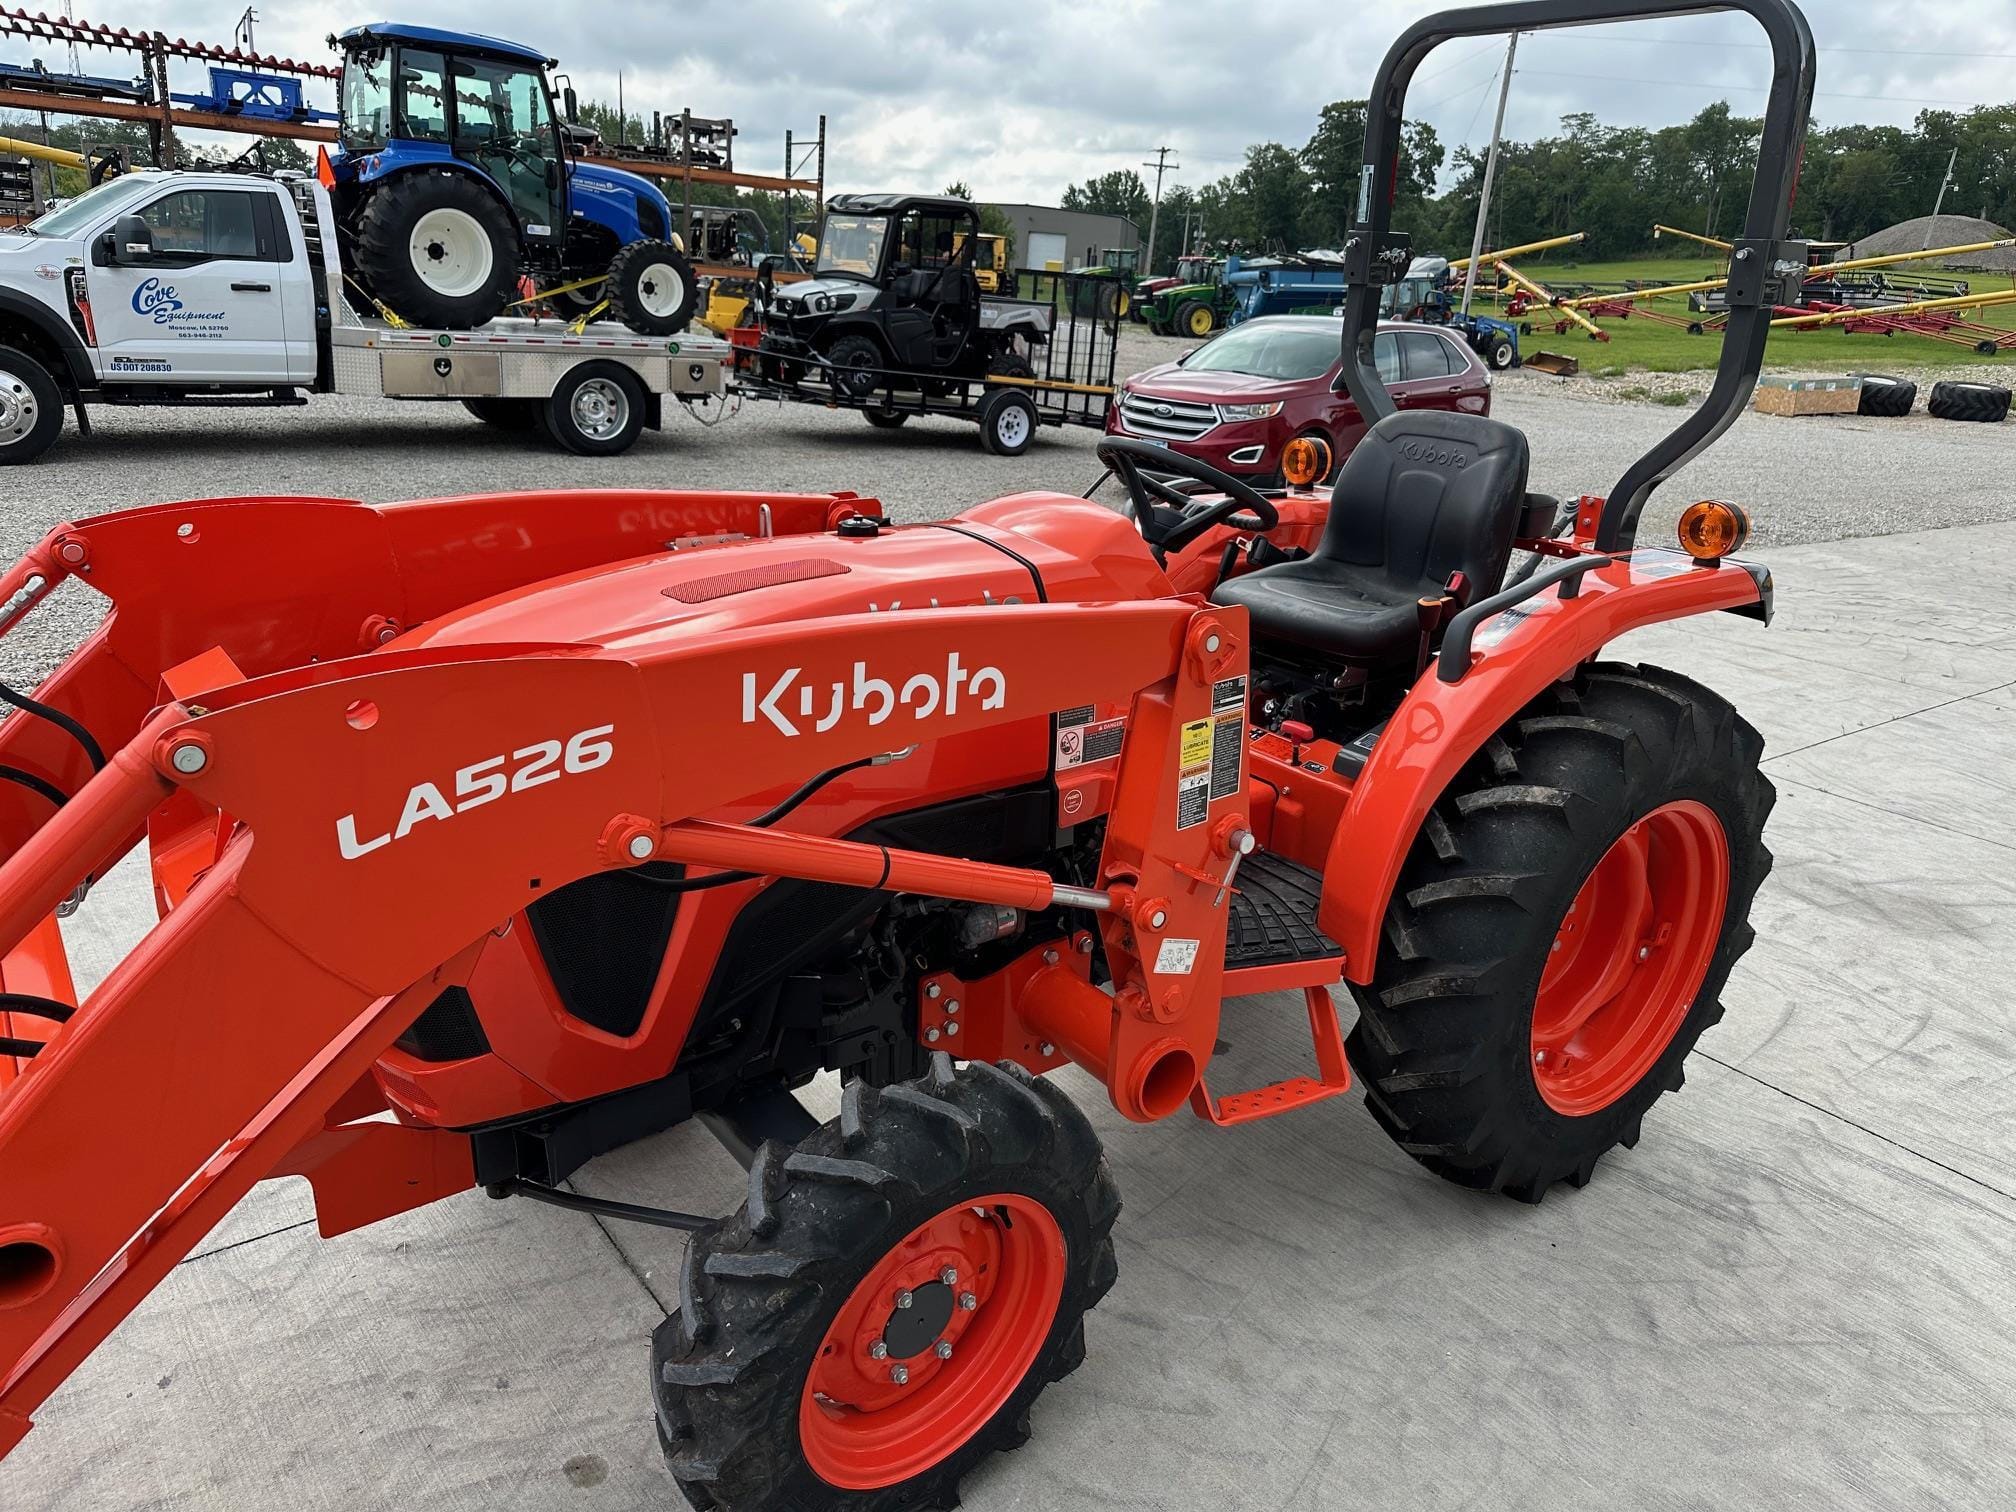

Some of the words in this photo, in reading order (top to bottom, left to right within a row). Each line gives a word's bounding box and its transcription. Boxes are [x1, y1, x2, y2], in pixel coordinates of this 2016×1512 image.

[132, 277, 183, 315] Cove
[153, 307, 225, 325] Equipment
[110, 363, 122, 371] US
[123, 363, 139, 371] DOT
[140, 364, 172, 372] 208830
[1398, 441, 1468, 468] Kubota
[742, 651, 1006, 737] Kubota
[1103, 720, 1123, 730] DANGER
[1184, 739, 1209, 751] LUBRICATE
[336, 723, 614, 860] LA526
